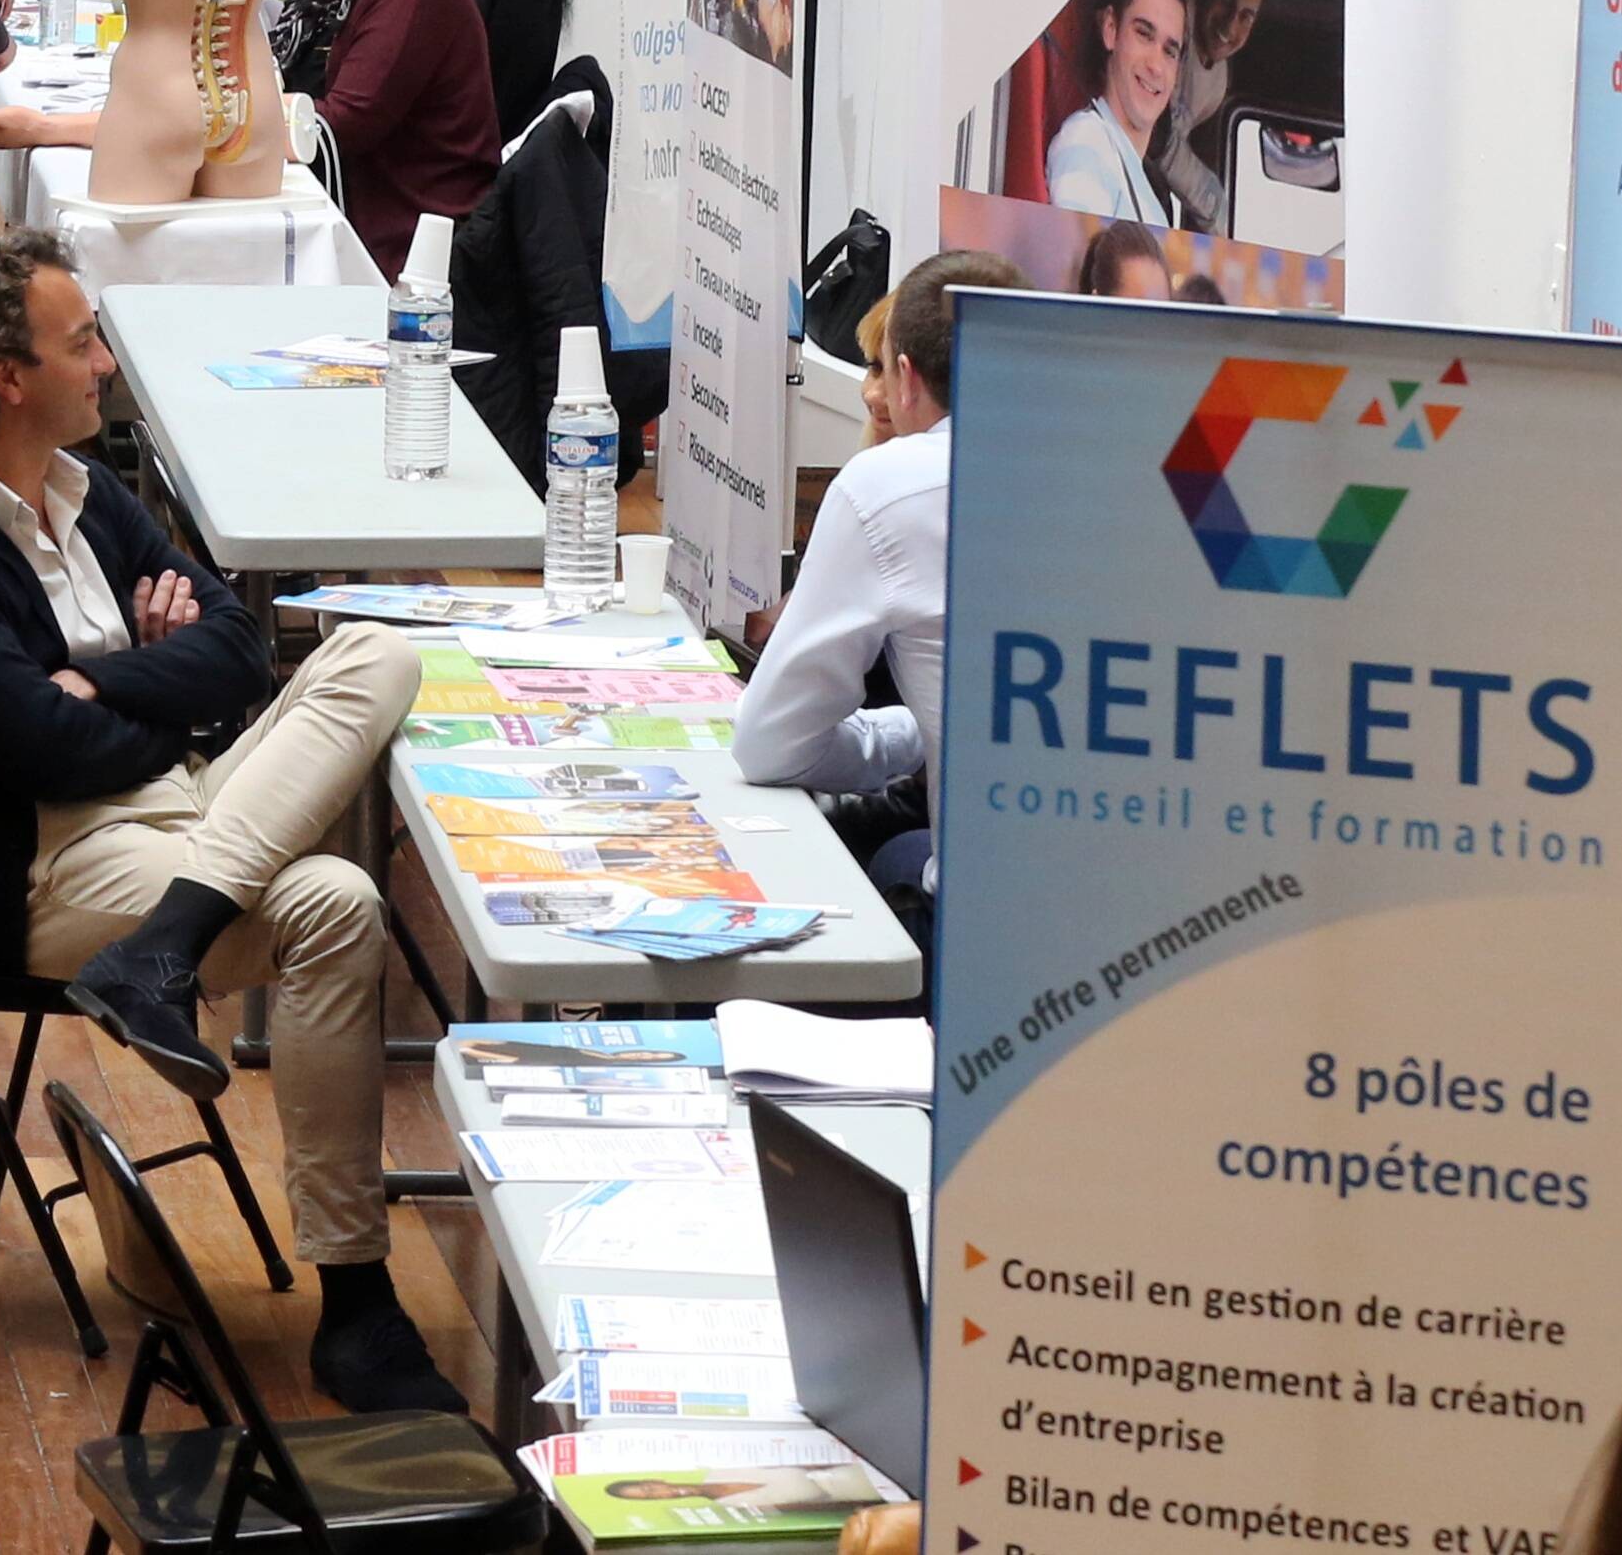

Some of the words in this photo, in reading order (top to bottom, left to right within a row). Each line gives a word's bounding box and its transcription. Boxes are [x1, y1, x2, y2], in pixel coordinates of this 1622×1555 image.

[695, 256, 723, 297] Travaux
[731, 279, 761, 323] hauteur
[692, 314, 723, 359] Incendie
[691, 373, 730, 425] Secourisme
[689, 431, 715, 477] Risques
[715, 458, 766, 510] professionnels
[991, 631, 1595, 795] REFLETS
[988, 777, 1192, 829] conseil
[1225, 796, 1275, 839] et
[1310, 800, 1604, 868] formation
[950, 1033, 1015, 1097] Une
[1018, 976, 1095, 1042] offre
[1100, 868, 1304, 999] permanente
[1305, 1051, 1337, 1098] 8
[1356, 1058, 1505, 1115] pôles
[1524, 1071, 1592, 1123] de
[1217, 1138, 1590, 1213] compétences
[1000, 1258, 1135, 1303] Conseil
[1147, 1277, 1191, 1308] en
[1203, 1286, 1342, 1326] gestion
[1355, 1293, 1403, 1330] de
[1415, 1308, 1567, 1347] carrière
[1007, 1335, 1341, 1402] Accompagnement
[1352, 1368, 1373, 1405] à
[1386, 1373, 1418, 1410] la
[1430, 1380, 1586, 1425] création
[1000, 1399, 1226, 1456] d'entreprise
[1005, 1475, 1095, 1515] Bilan
[1108, 1483, 1151, 1522] de
[1161, 1495, 1410, 1549] compétences
[1433, 1525, 1469, 1553] et
